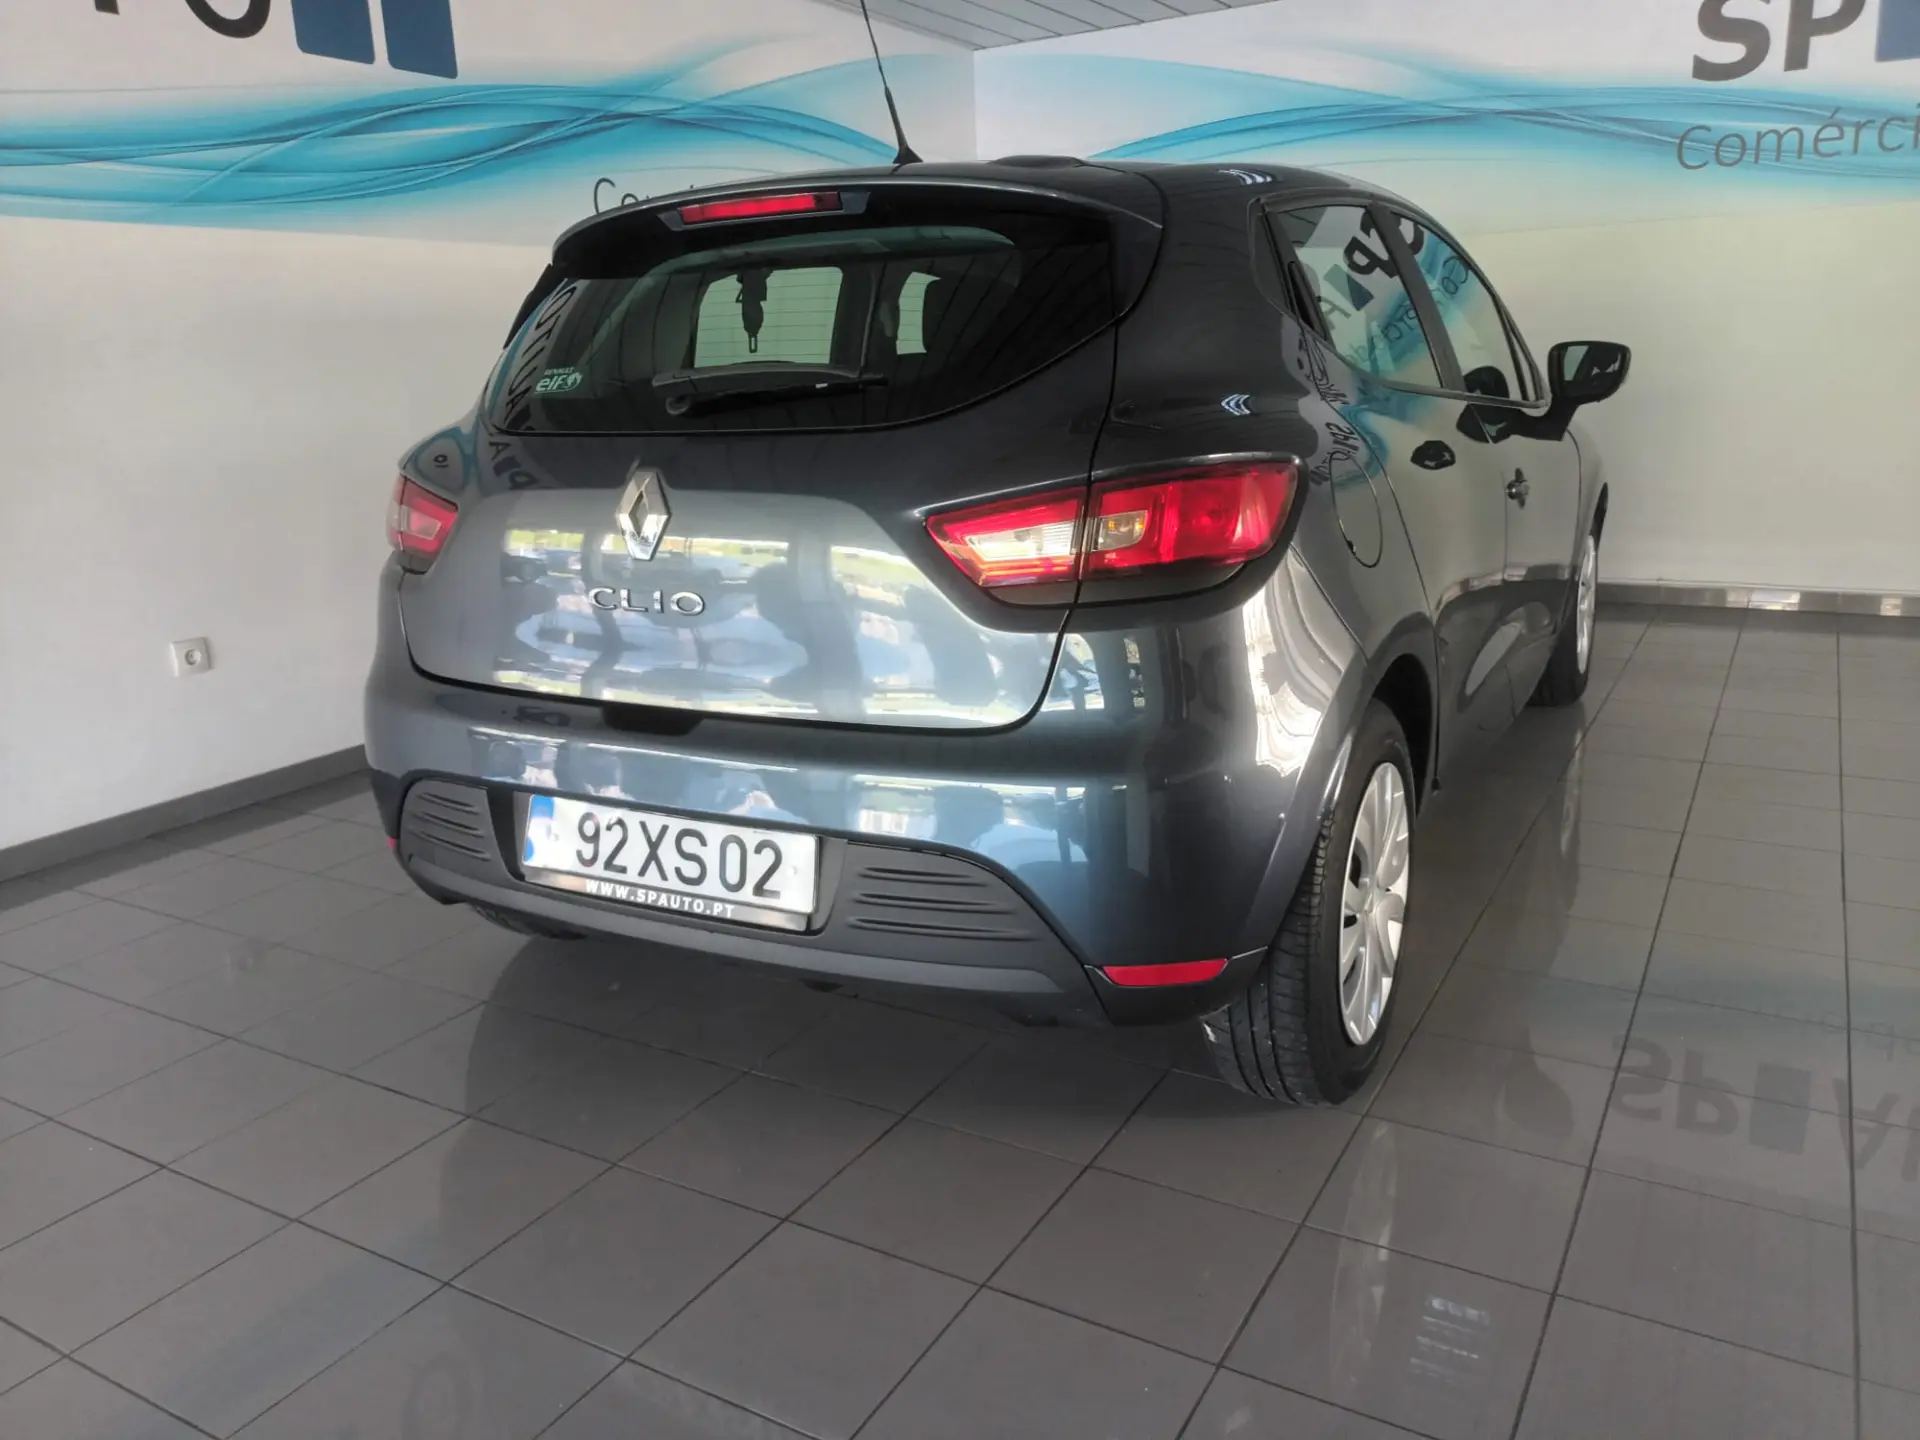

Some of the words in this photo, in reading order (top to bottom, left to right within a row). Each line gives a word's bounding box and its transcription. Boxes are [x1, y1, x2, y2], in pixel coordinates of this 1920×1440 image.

[535, 374, 568, 392] elf
[588, 586, 705, 616] CLIO
[576, 811, 782, 900] 92XS02
[585, 880, 736, 918] WWW.SPAUTO.PT
